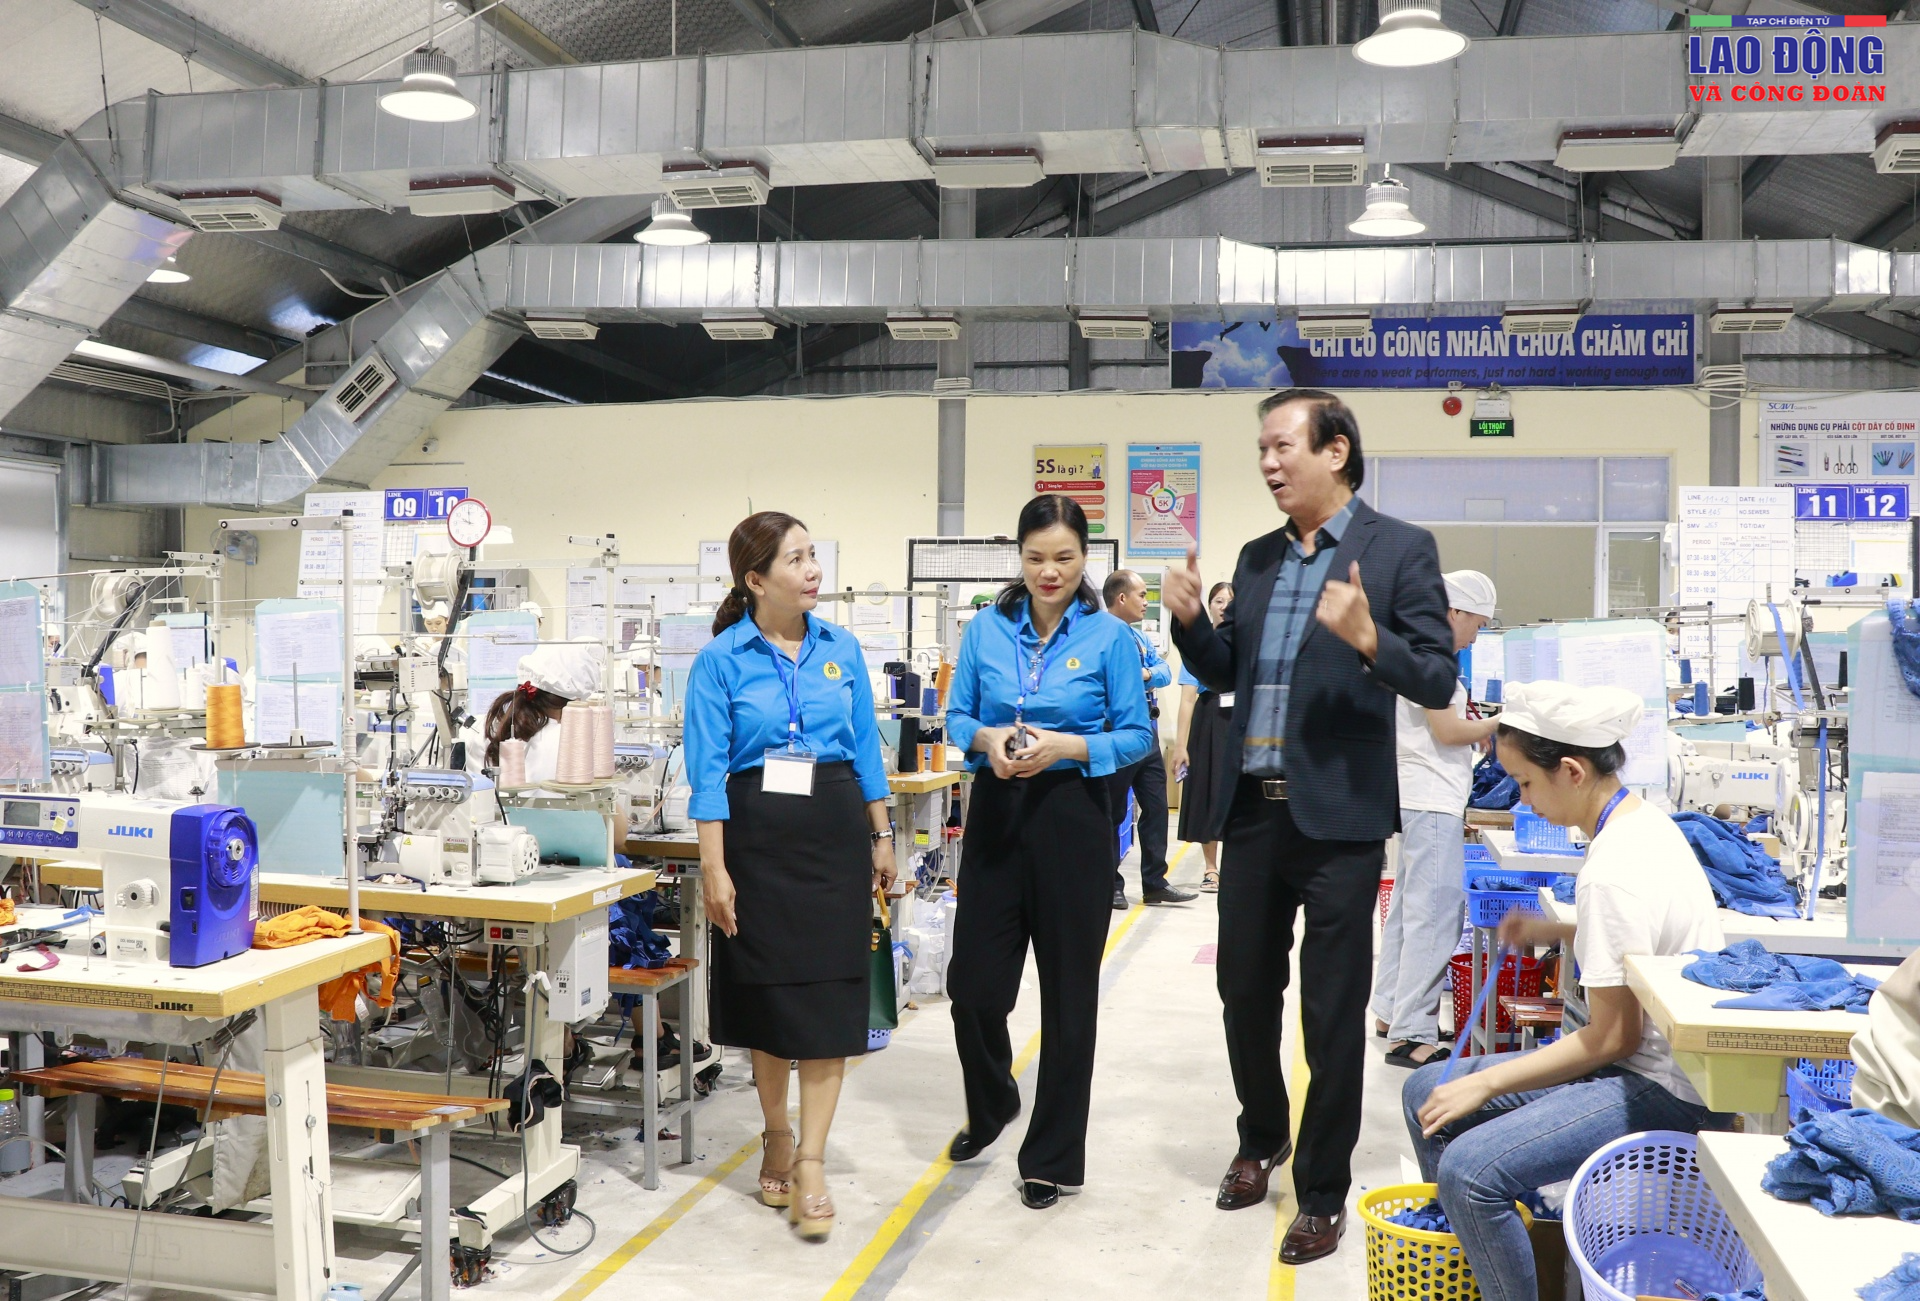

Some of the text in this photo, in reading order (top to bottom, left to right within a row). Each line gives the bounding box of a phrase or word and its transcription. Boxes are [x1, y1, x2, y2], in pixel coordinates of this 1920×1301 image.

[1383, 325, 1440, 357] CÔNG
[1446, 325, 1510, 357] NHÂN
[1581, 324, 1646, 356] CHĂM
[1652, 322, 1688, 356] CHỈ
[1313, 367, 1338, 378] here
[1342, 369, 1360, 378] are
[1364, 369, 1378, 378] no
[1382, 367, 1412, 378] weak
[1415, 367, 1480, 380] performers,
[1483, 367, 1504, 380] just
[1507, 367, 1526, 378] not
[1529, 367, 1556, 378] hard
[1566, 366, 1611, 380] working
[1614, 366, 1659, 380] enough
[1662, 366, 1688, 380] only
[1488, 421, 1506, 430] THOÁT
[1770, 420, 1796, 430] NHỮNG
[1798, 423, 1818, 432] DỤNG
[1820, 423, 1830, 432] CỤ
[1832, 421, 1850, 430] PHẢI
[1852, 422, 1866, 432] CỘT
[1868, 421, 1882, 430] DÂY
[1896, 422, 1916, 432] ĐỊNH
[1036, 459, 1084, 475] 5S là gì ?
[393, 498, 417, 517] 09
[436, 496, 458, 516] 10
[1809, 495, 1836, 516] 11
[1865, 495, 1896, 516] 12
[1732, 772, 1768, 780] JUKI
[108, 825, 153, 838] JUKI
[154, 1002, 193, 1011] JUKI
